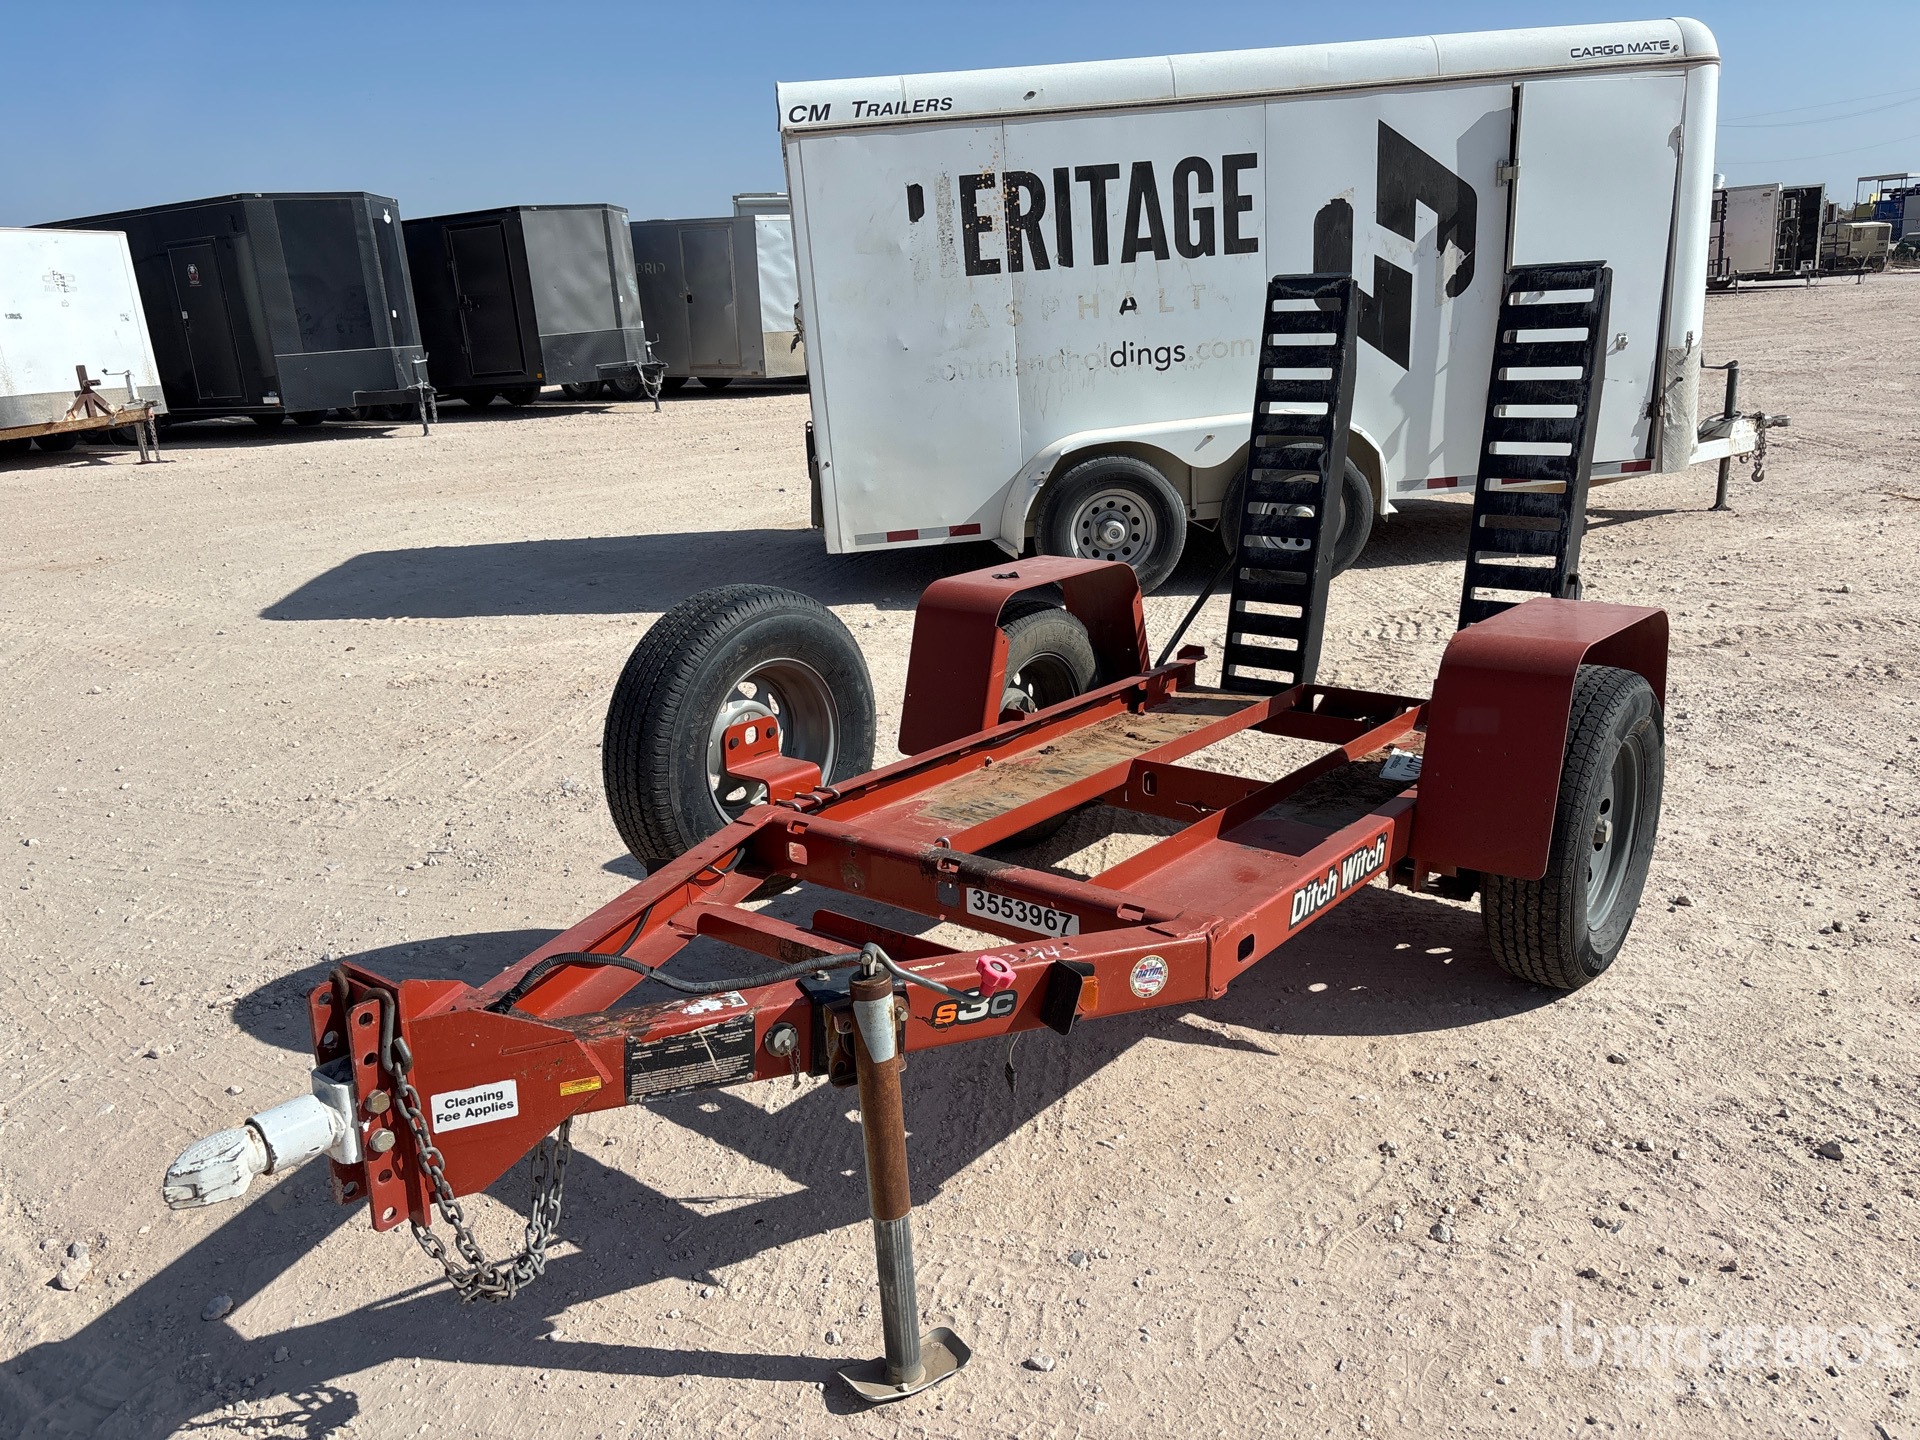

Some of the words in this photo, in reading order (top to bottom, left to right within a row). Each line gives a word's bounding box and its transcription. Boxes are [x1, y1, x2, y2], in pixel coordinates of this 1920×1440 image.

[1570, 44, 1624, 58] CARGO
[1627, 39, 1671, 53] MATE
[788, 103, 832, 123] CM
[852, 97, 953, 118] TRAILERS
[907, 153, 1258, 278] ERITAGE
[1290, 867, 1338, 926] Ditch
[1342, 837, 1385, 890] Witch
[972, 890, 1073, 933] 3553967
[436, 1112, 461, 1124] Fee
[465, 1101, 514, 1118] Applies
[444, 1090, 504, 1109] Cleaning
